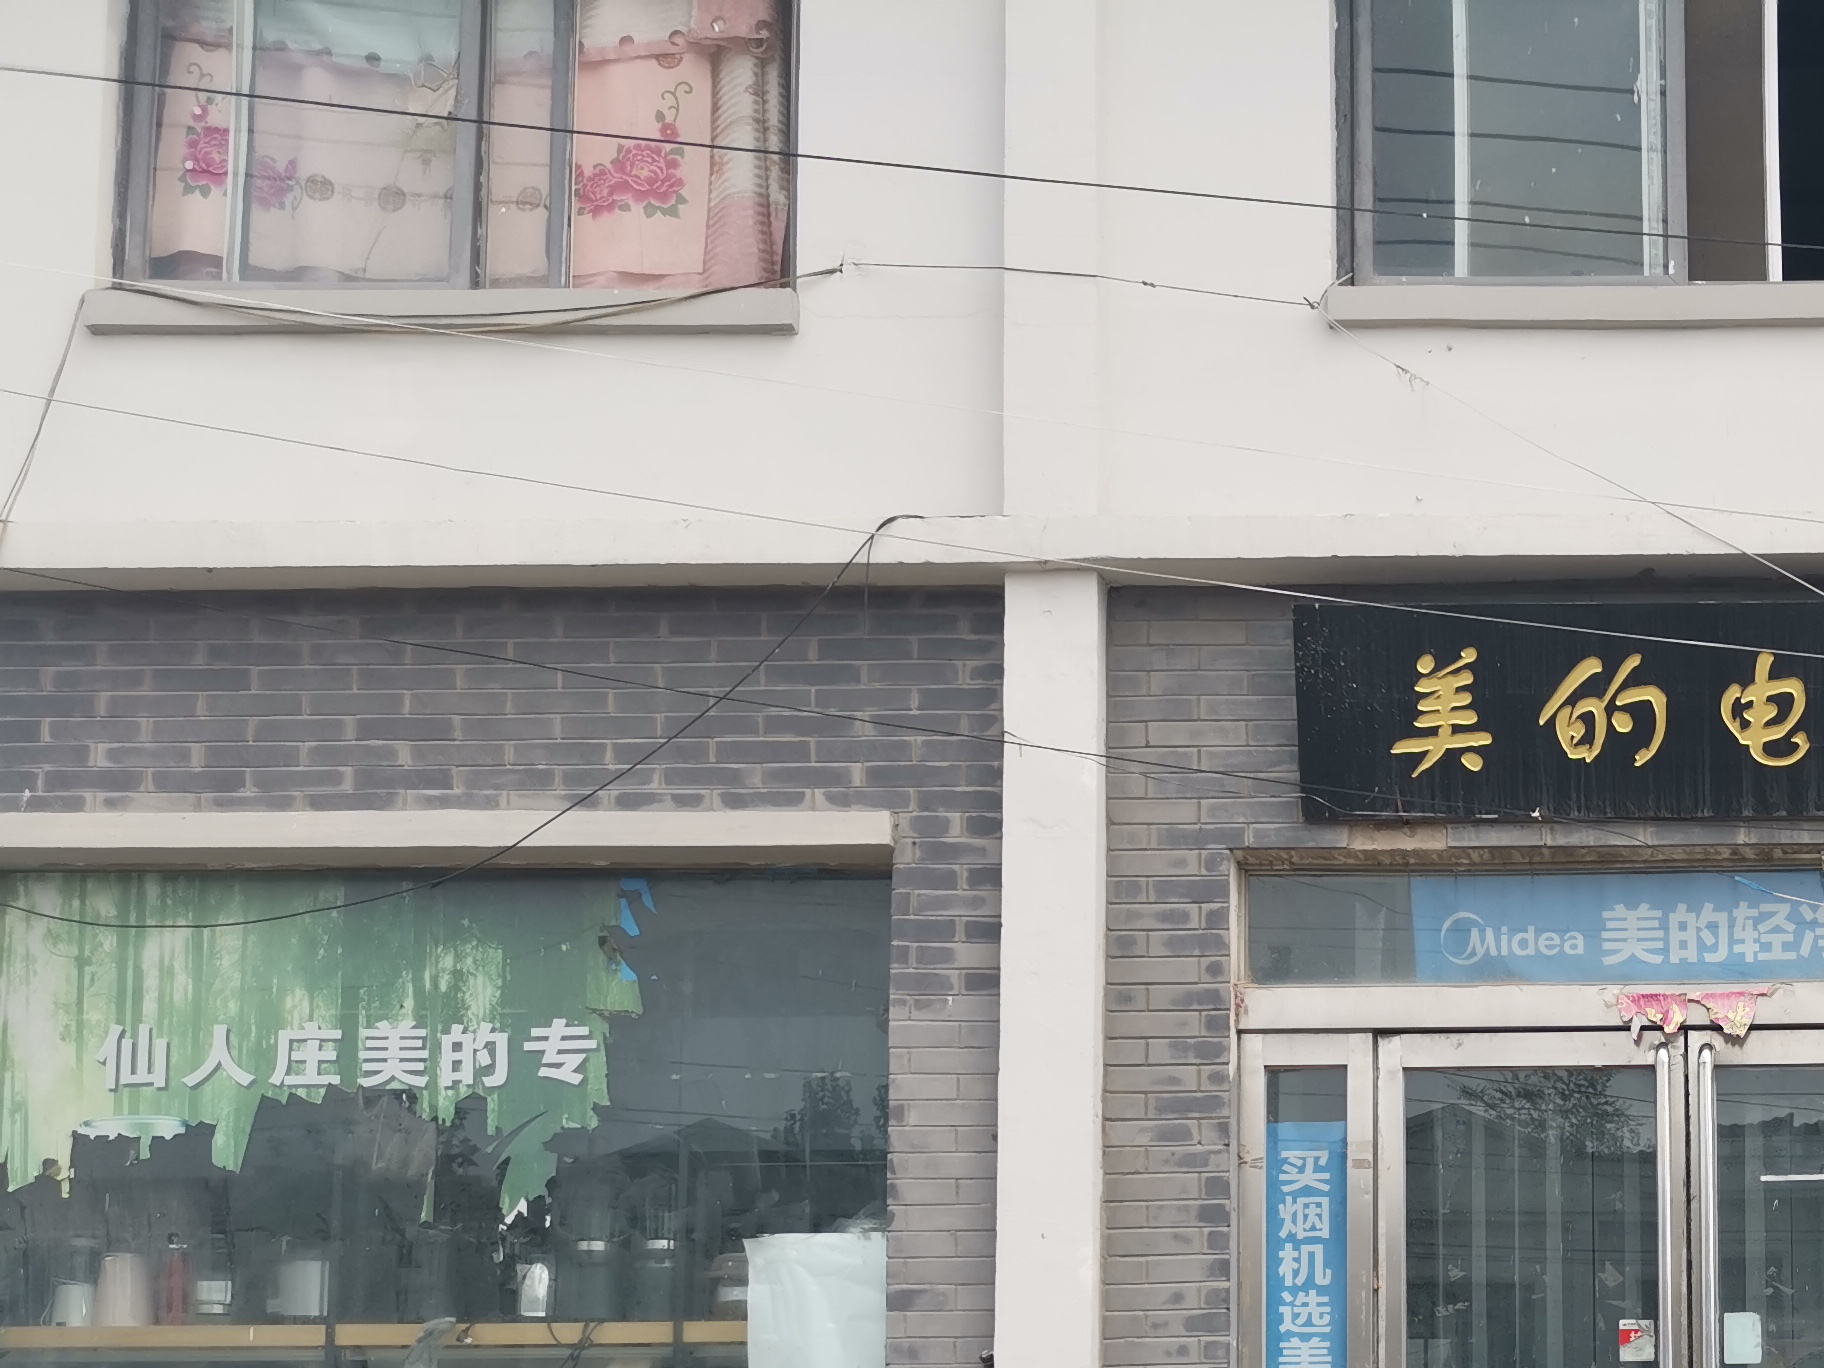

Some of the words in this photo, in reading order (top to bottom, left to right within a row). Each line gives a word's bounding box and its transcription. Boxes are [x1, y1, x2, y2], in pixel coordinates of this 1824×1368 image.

[1440, 911, 1585, 965] Midea
[96, 1017, 601, 1090] 仙人庄美的专
